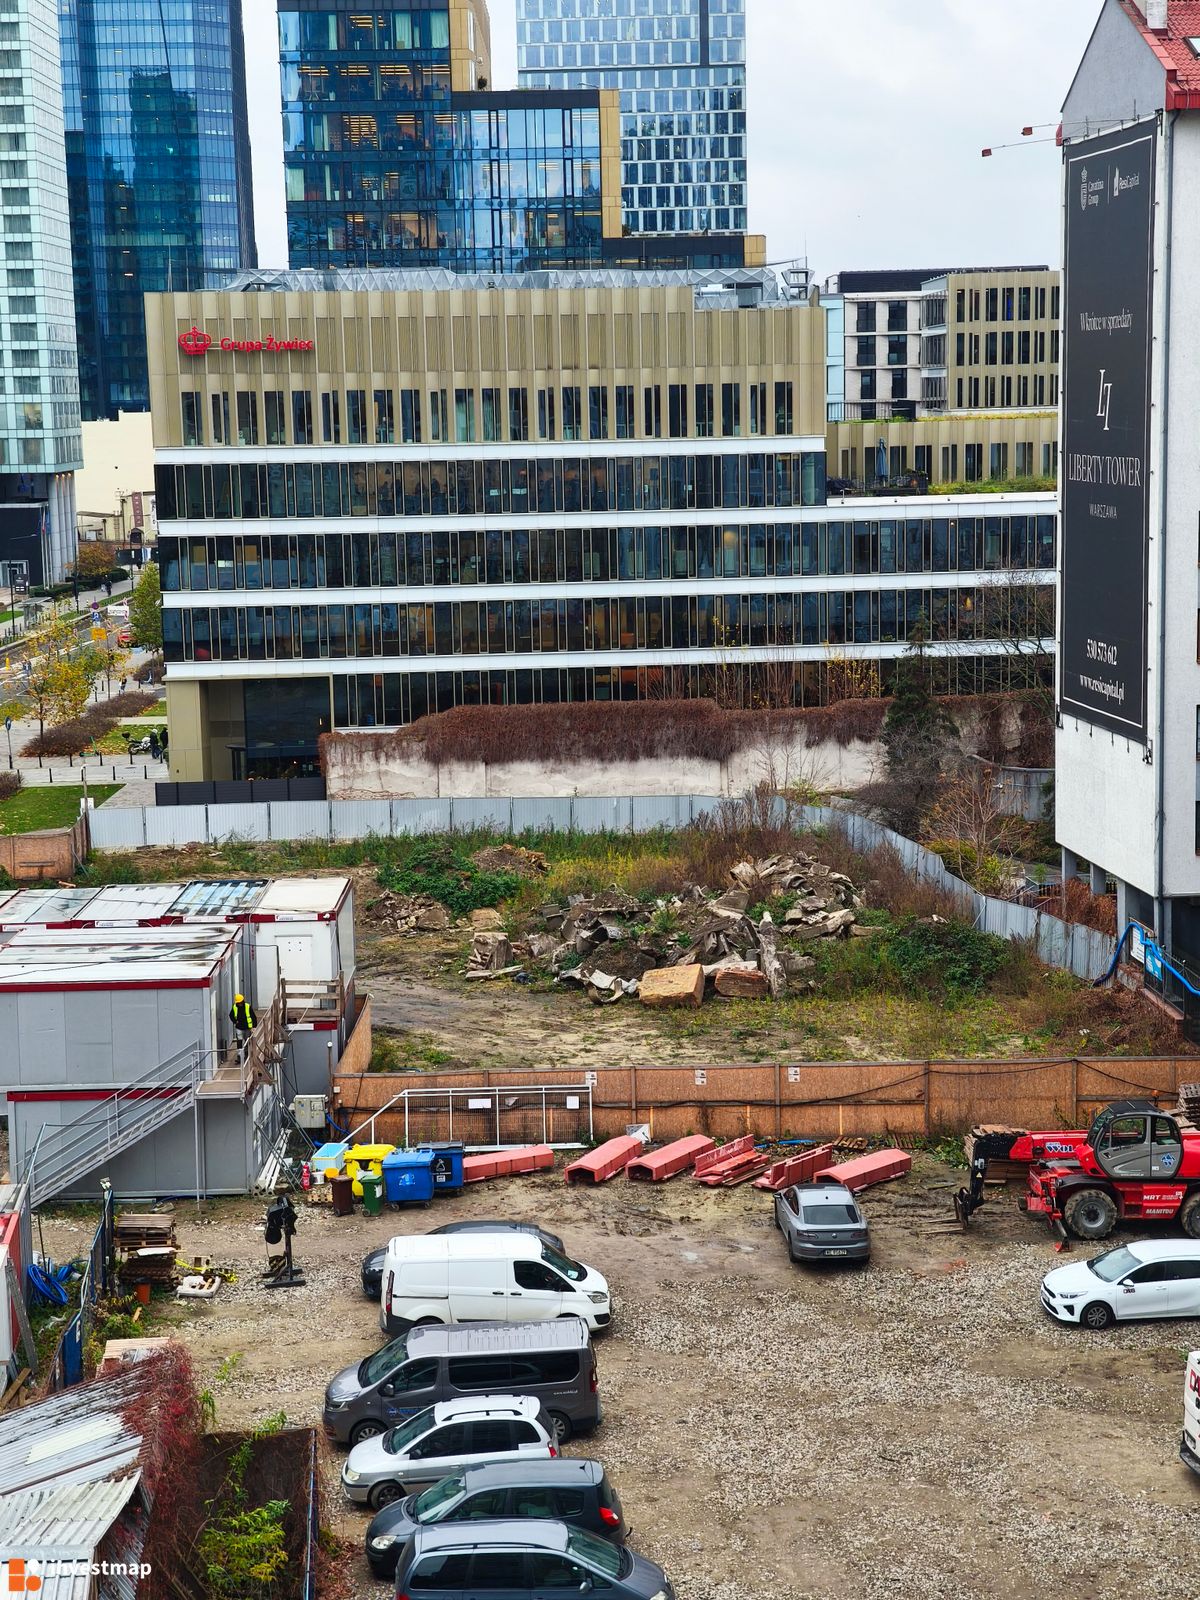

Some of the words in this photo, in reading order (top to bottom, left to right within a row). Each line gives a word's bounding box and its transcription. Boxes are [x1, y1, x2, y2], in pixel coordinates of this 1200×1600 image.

[220, 337, 263, 352] Grupa
[266, 334, 313, 352] Żywiec
[1069, 453, 1105, 484] LIBERTY
[1106, 456, 1141, 487] TOWER
[1089, 503, 1118, 519] WARSZAWA
